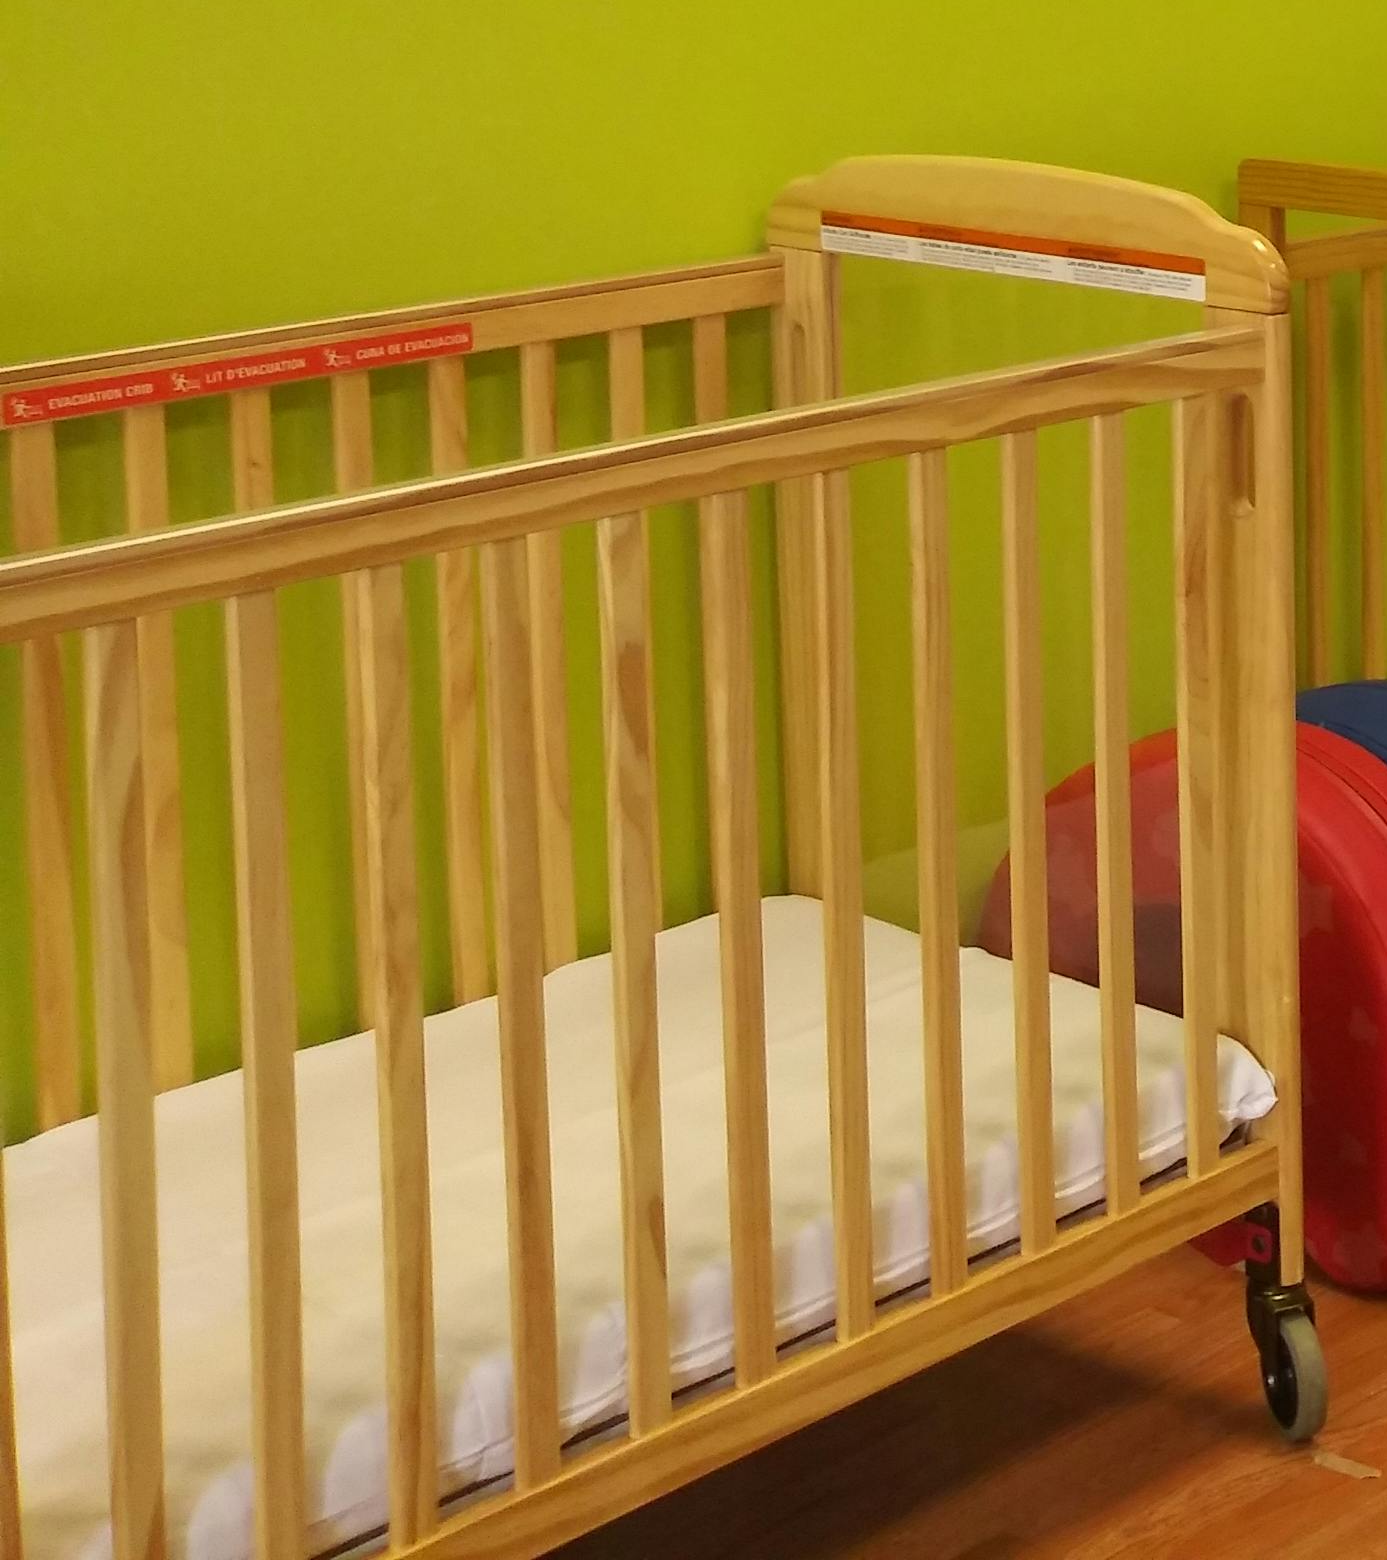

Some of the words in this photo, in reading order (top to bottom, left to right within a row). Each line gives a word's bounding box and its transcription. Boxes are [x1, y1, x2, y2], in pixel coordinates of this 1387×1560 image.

[387, 343, 401, 355] DE
[205, 371, 223, 384] LIT
[48, 388, 122, 410] EVACUATION
[125, 383, 154, 397] CRIB
